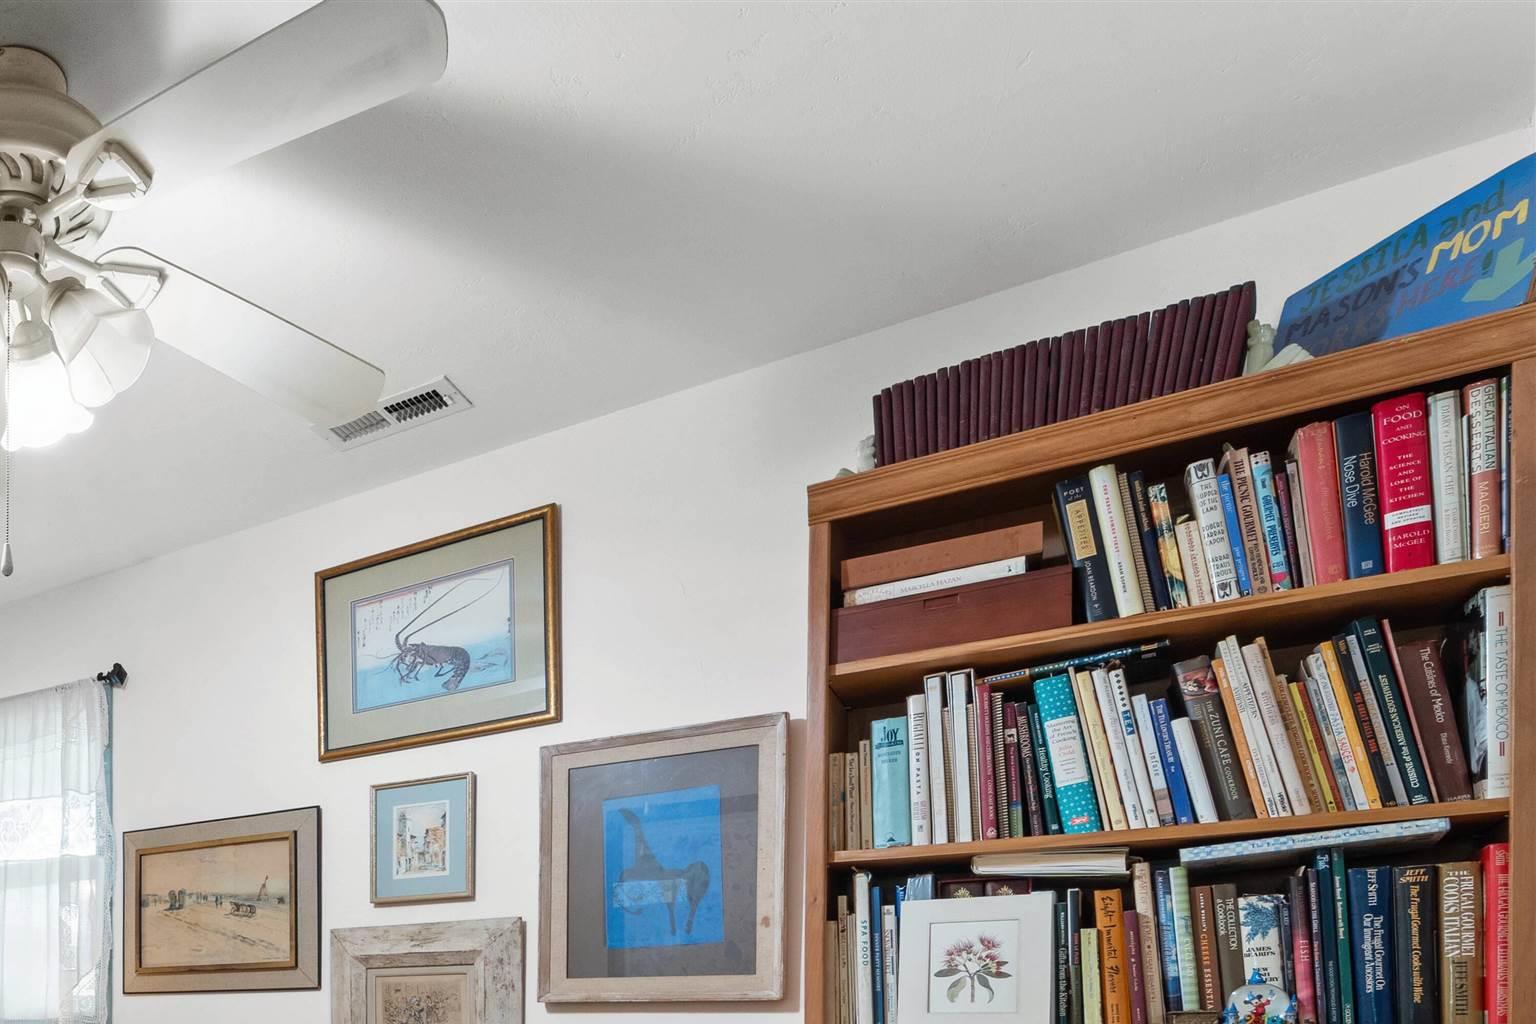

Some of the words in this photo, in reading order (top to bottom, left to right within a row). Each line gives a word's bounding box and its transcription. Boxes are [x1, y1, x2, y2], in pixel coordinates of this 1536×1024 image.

[1440, 180, 1505, 239] and
[1425, 198, 1529, 274] MOM
[1484, 386, 1495, 422] GREAT
[1383, 409, 1423, 426] FOOD
[1483, 425, 1496, 469] ITALIAN
[1233, 459, 1246, 475] THE
[1343, 455, 1358, 483] Nose
[1358, 452, 1373, 486] Harold
[1237, 476, 1251, 503] PICNIC
[1345, 485, 1361, 508] Dive
[1362, 488, 1376, 524] McGee
[1478, 481, 1490, 535] MALGIERI
[1241, 505, 1257, 544] GOURMET
[1495, 626, 1508, 648] THE
[1419, 647, 1431, 661] The
[1495, 649, 1508, 679] TASTE
[1423, 661, 1438, 689] Cuisines
[1429, 689, 1440, 697] of
[1495, 683, 1508, 698] OF
[1122, 712, 1133, 733] TEA
[1431, 698, 1446, 723] Mexico
[1495, 699, 1509, 740] MEXICO
[1017, 715, 1032, 758] MUSHROOMS
[1038, 747, 1050, 772] Healthy
[1042, 773, 1053, 799] Cooking
[1367, 869, 1378, 883] JEFF
[1399, 875, 1429, 884] SMITH
[1368, 884, 1378, 906] SMITH
[1410, 885, 1419, 898] The
[1443, 876, 1459, 913] COOKS
[1460, 876, 1474, 911] FRUGAL
[1363, 913, 1373, 927] Our
[1408, 898, 1420, 919] Frugal
[1373, 916, 1383, 929] The
[1411, 920, 1421, 949] Gourmet
[1461, 912, 1475, 957] GOURMET
[1246, 945, 1273, 954] JAMES
[1361, 928, 1374, 960] Immigrant
[1372, 929, 1384, 950] Frugal
[1445, 916, 1460, 958] ITALIAN
[861, 941, 869, 967] FOOD
[1299, 940, 1309, 962] FISH
[1412, 951, 1422, 971] Cooks
[1365, 961, 1374, 993] Ancestors
[1375, 950, 1385, 979] Gourmet
[1375, 980, 1385, 990] On
[1412, 971, 1422, 987] with
[1413, 987, 1424, 1003] Wine
